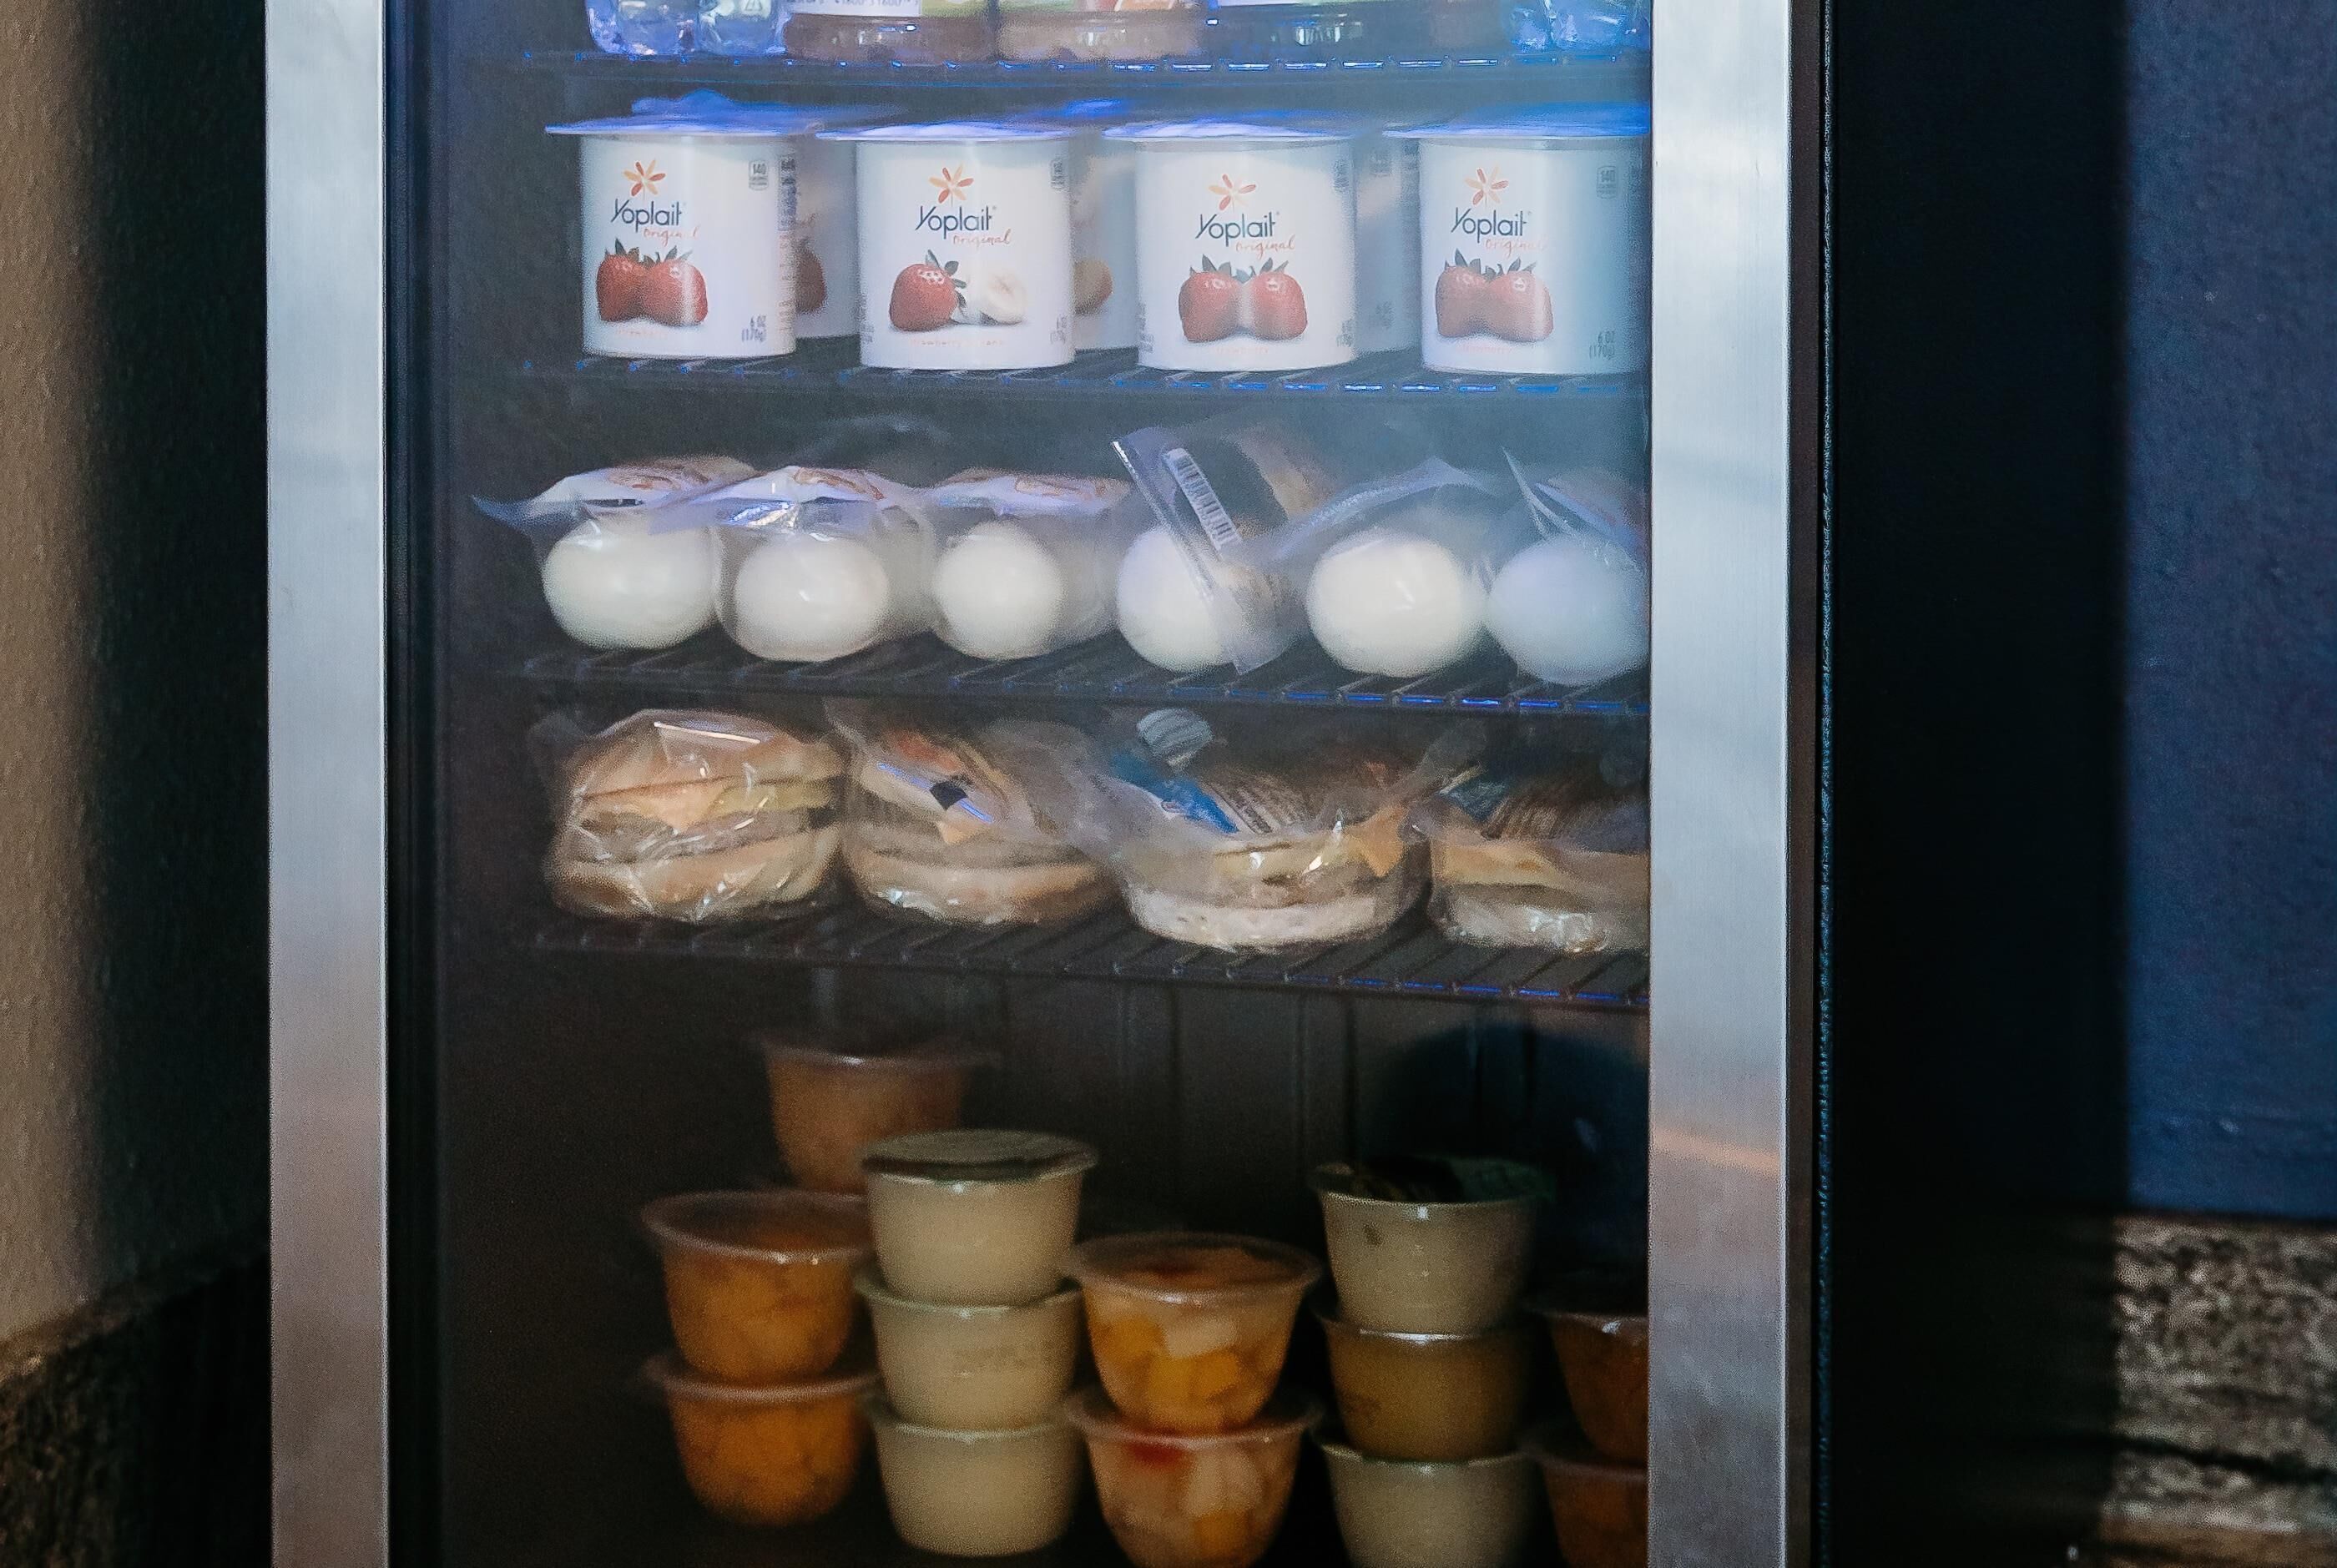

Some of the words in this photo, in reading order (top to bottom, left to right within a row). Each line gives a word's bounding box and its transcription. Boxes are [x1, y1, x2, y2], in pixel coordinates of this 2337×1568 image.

[610, 199, 683, 233] Yoplait
[915, 205, 992, 239] Yoplait
[1195, 211, 1276, 247] Yoplait
[1451, 207, 1527, 244] Yoplait
